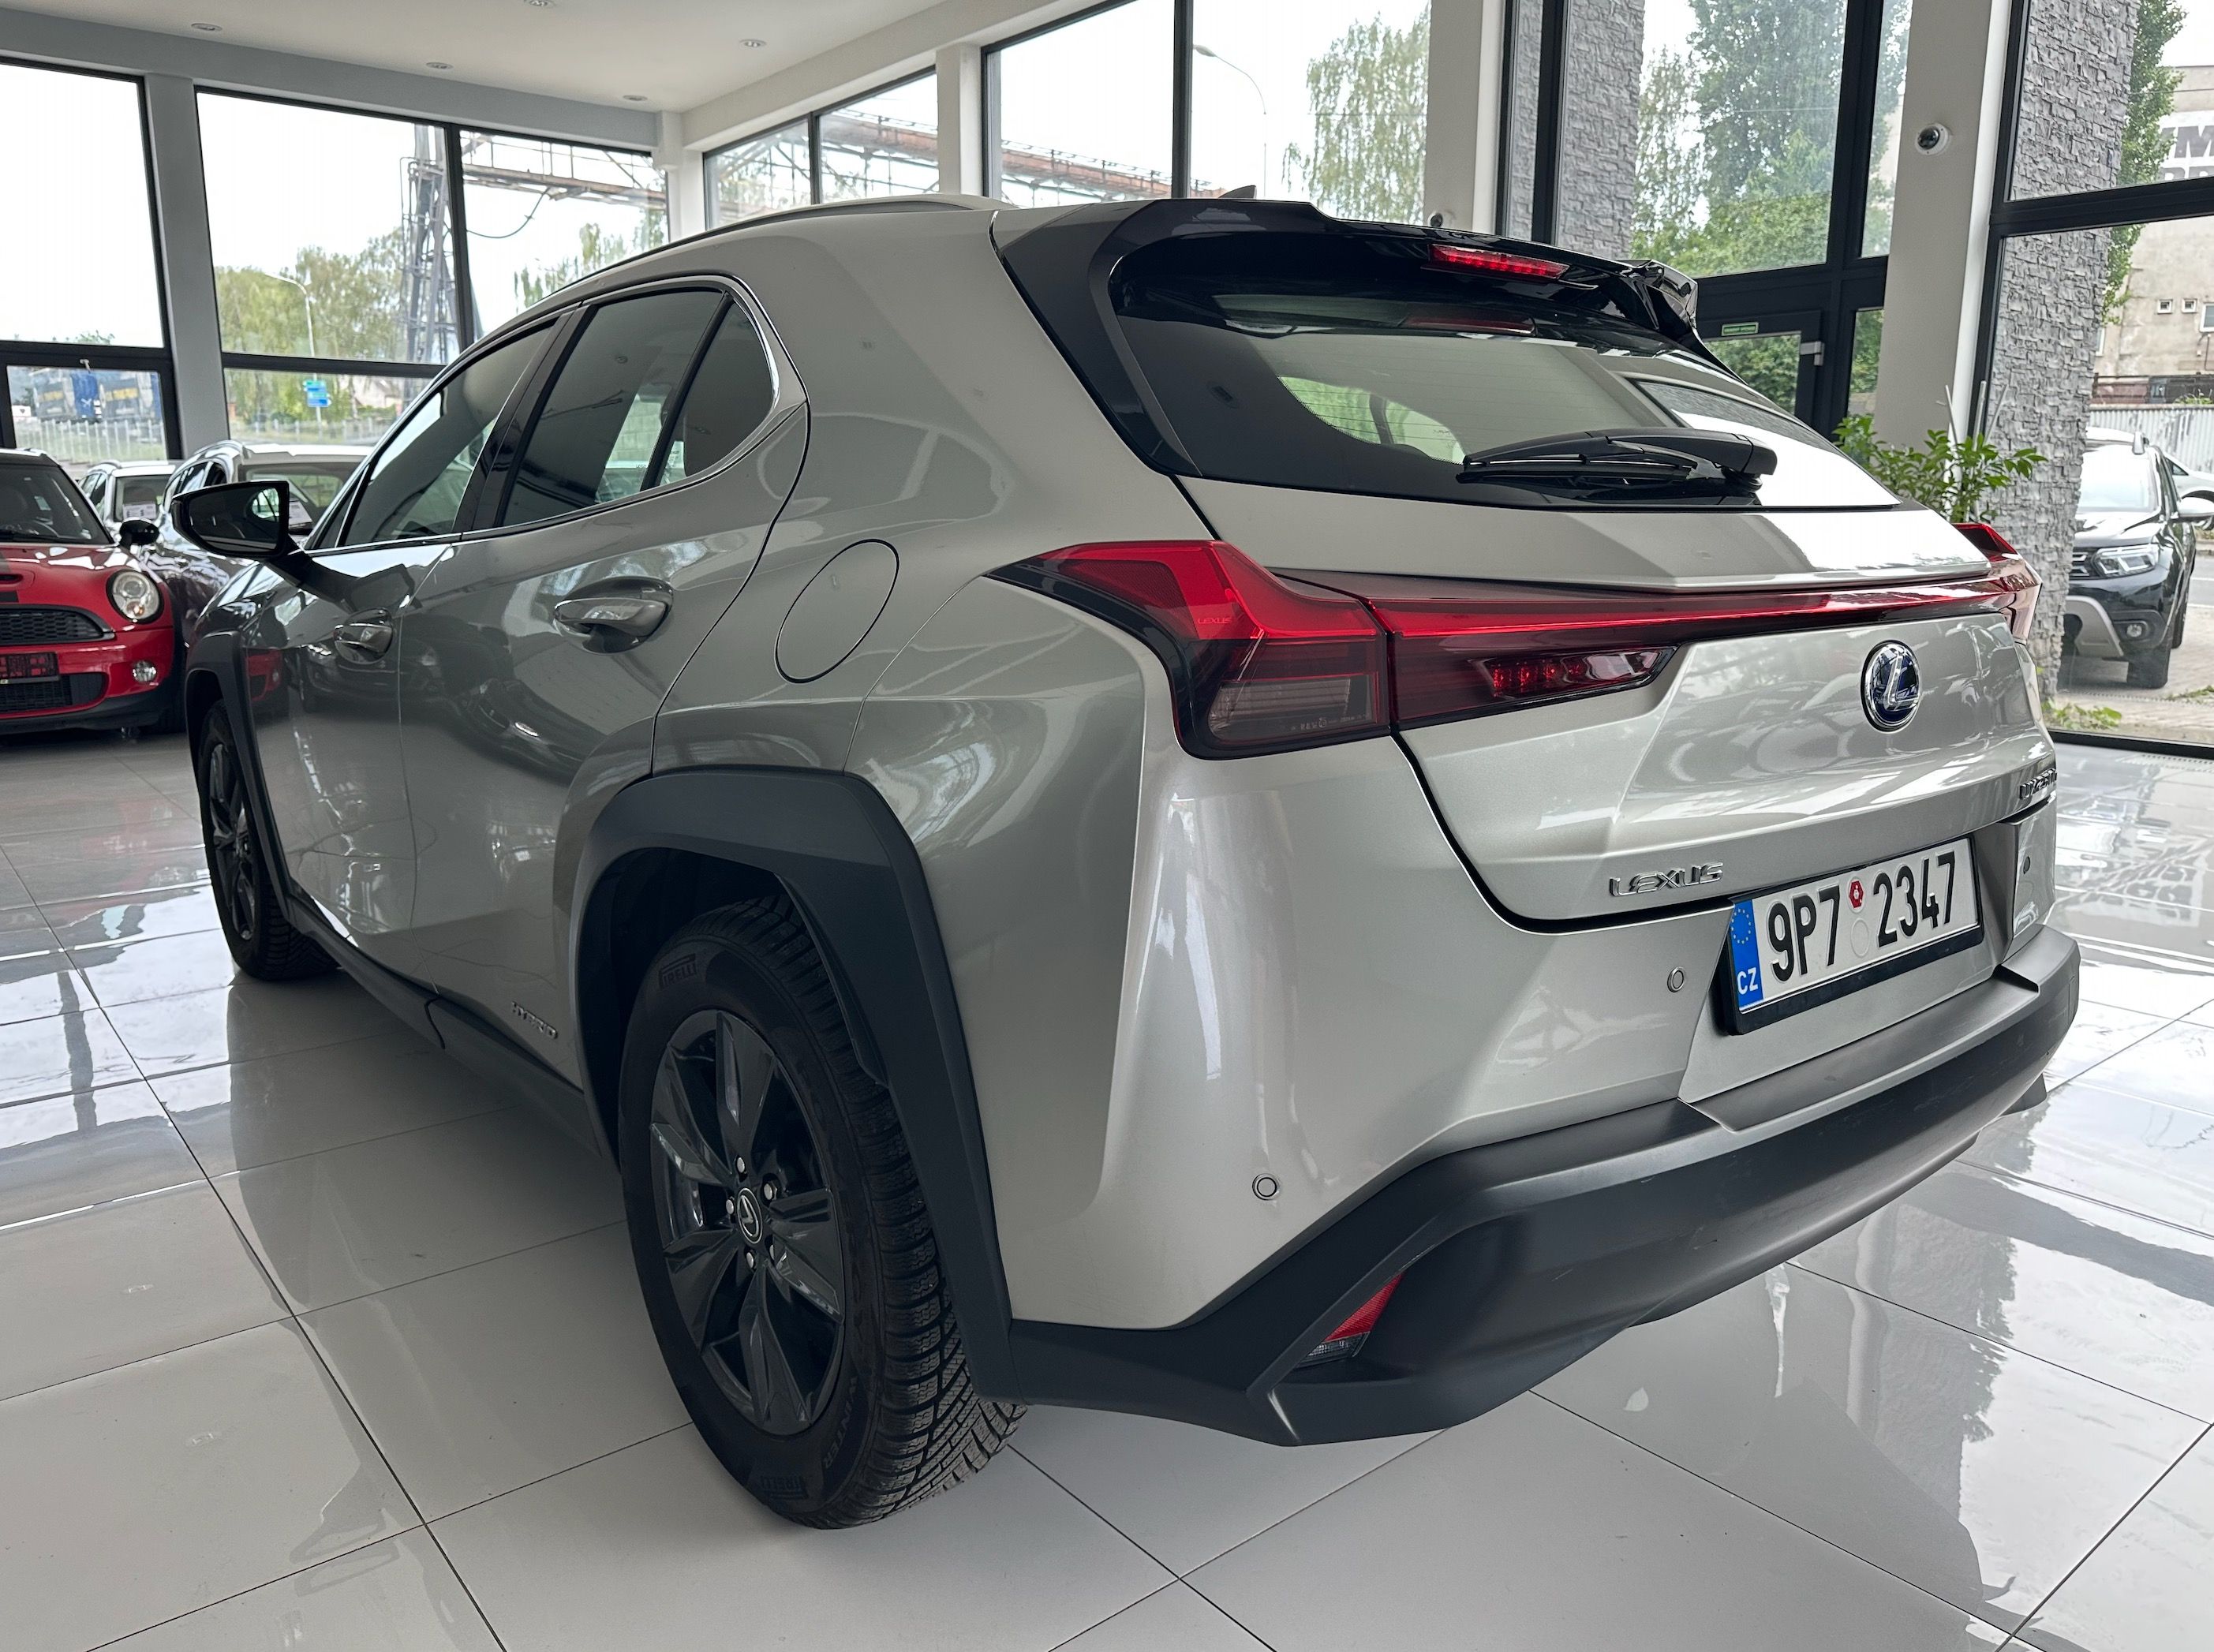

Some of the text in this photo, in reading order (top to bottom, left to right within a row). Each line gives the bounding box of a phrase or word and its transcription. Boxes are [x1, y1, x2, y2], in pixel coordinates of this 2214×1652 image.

[1609, 862, 1723, 896] LEXUS
[1737, 850, 1955, 995] CZ 9P7 2347
[659, 953, 697, 991] PIRELLI
